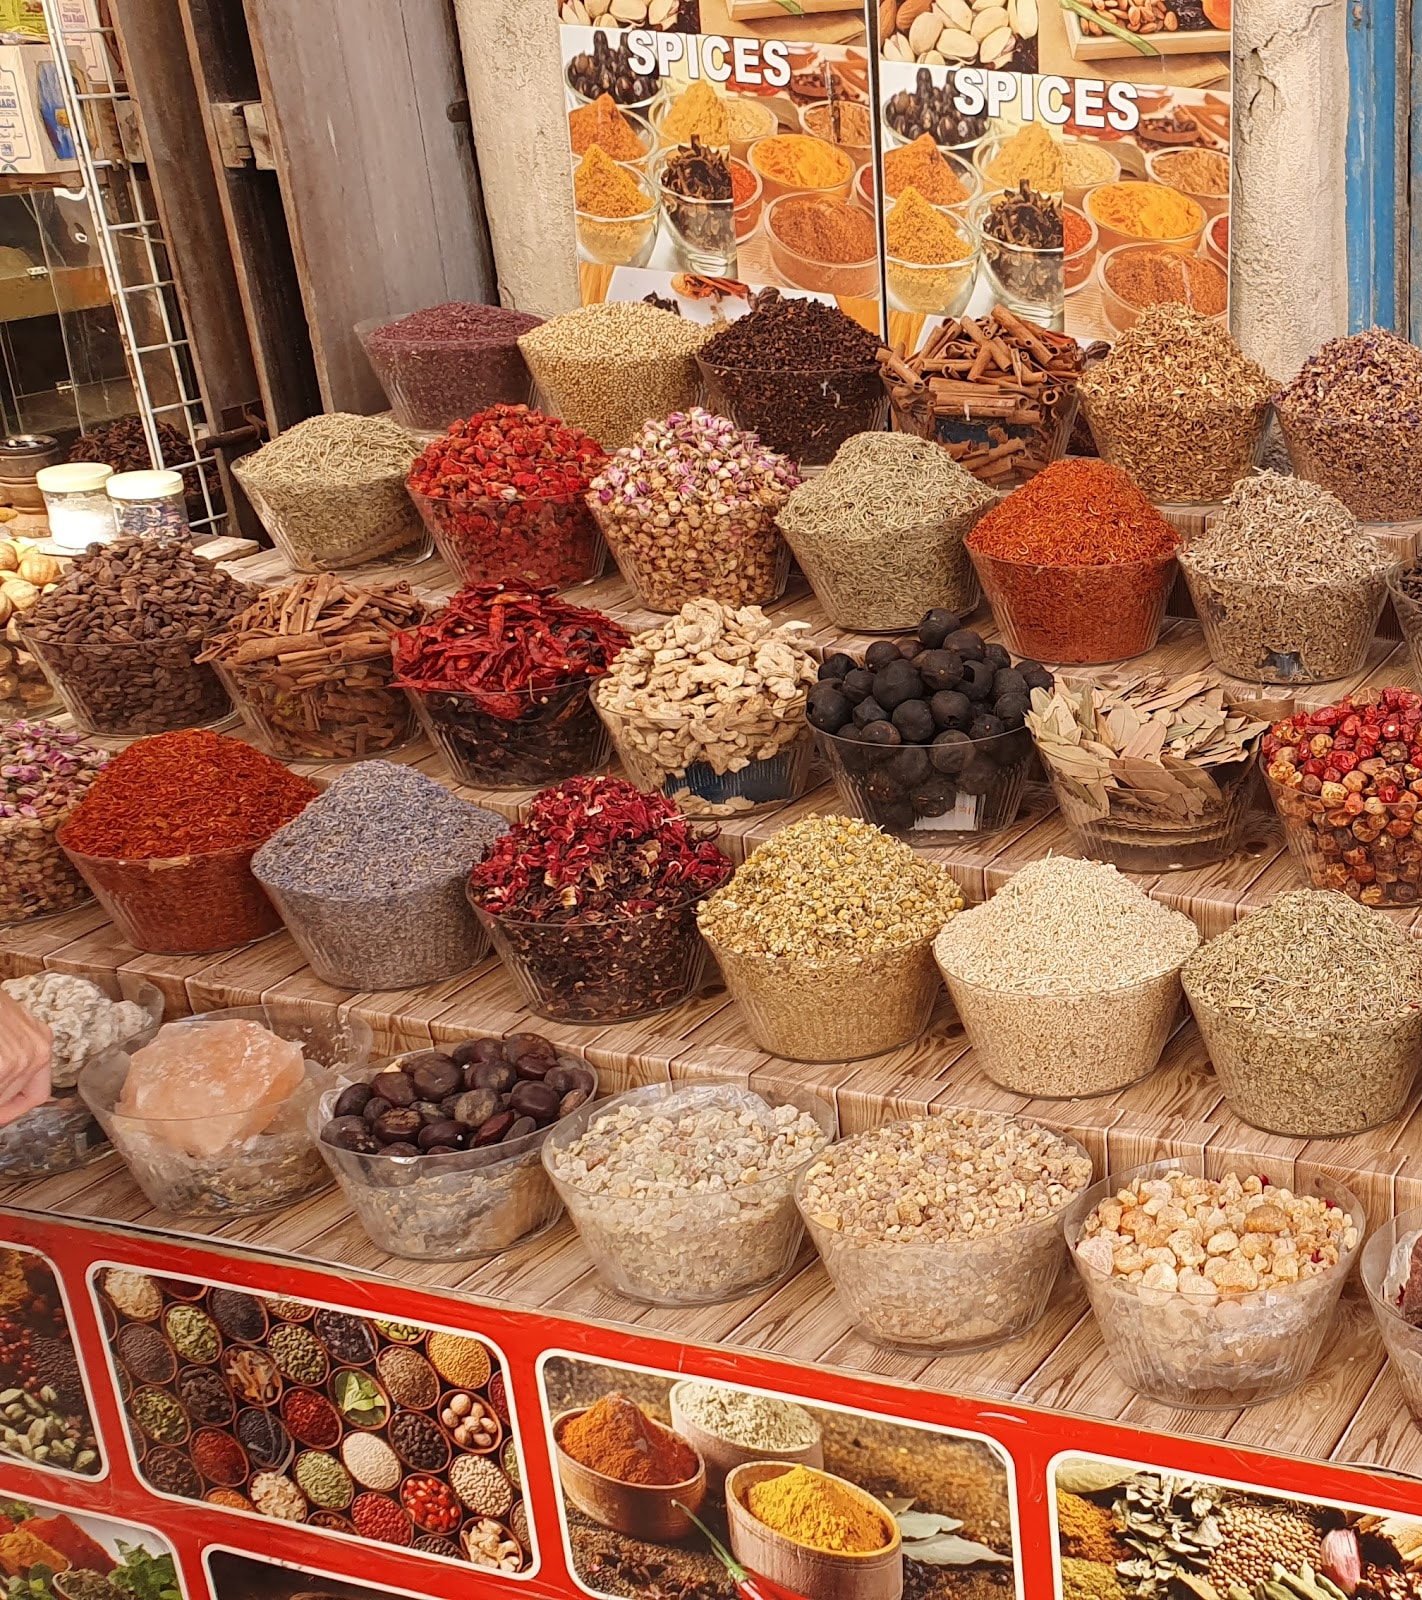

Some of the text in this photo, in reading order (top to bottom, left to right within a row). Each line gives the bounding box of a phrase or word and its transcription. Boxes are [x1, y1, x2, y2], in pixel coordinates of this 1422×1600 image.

[627, 29, 792, 88] SPICES
[0, 98, 17, 109] AGS
[953, 67, 1140, 132] SPICES
